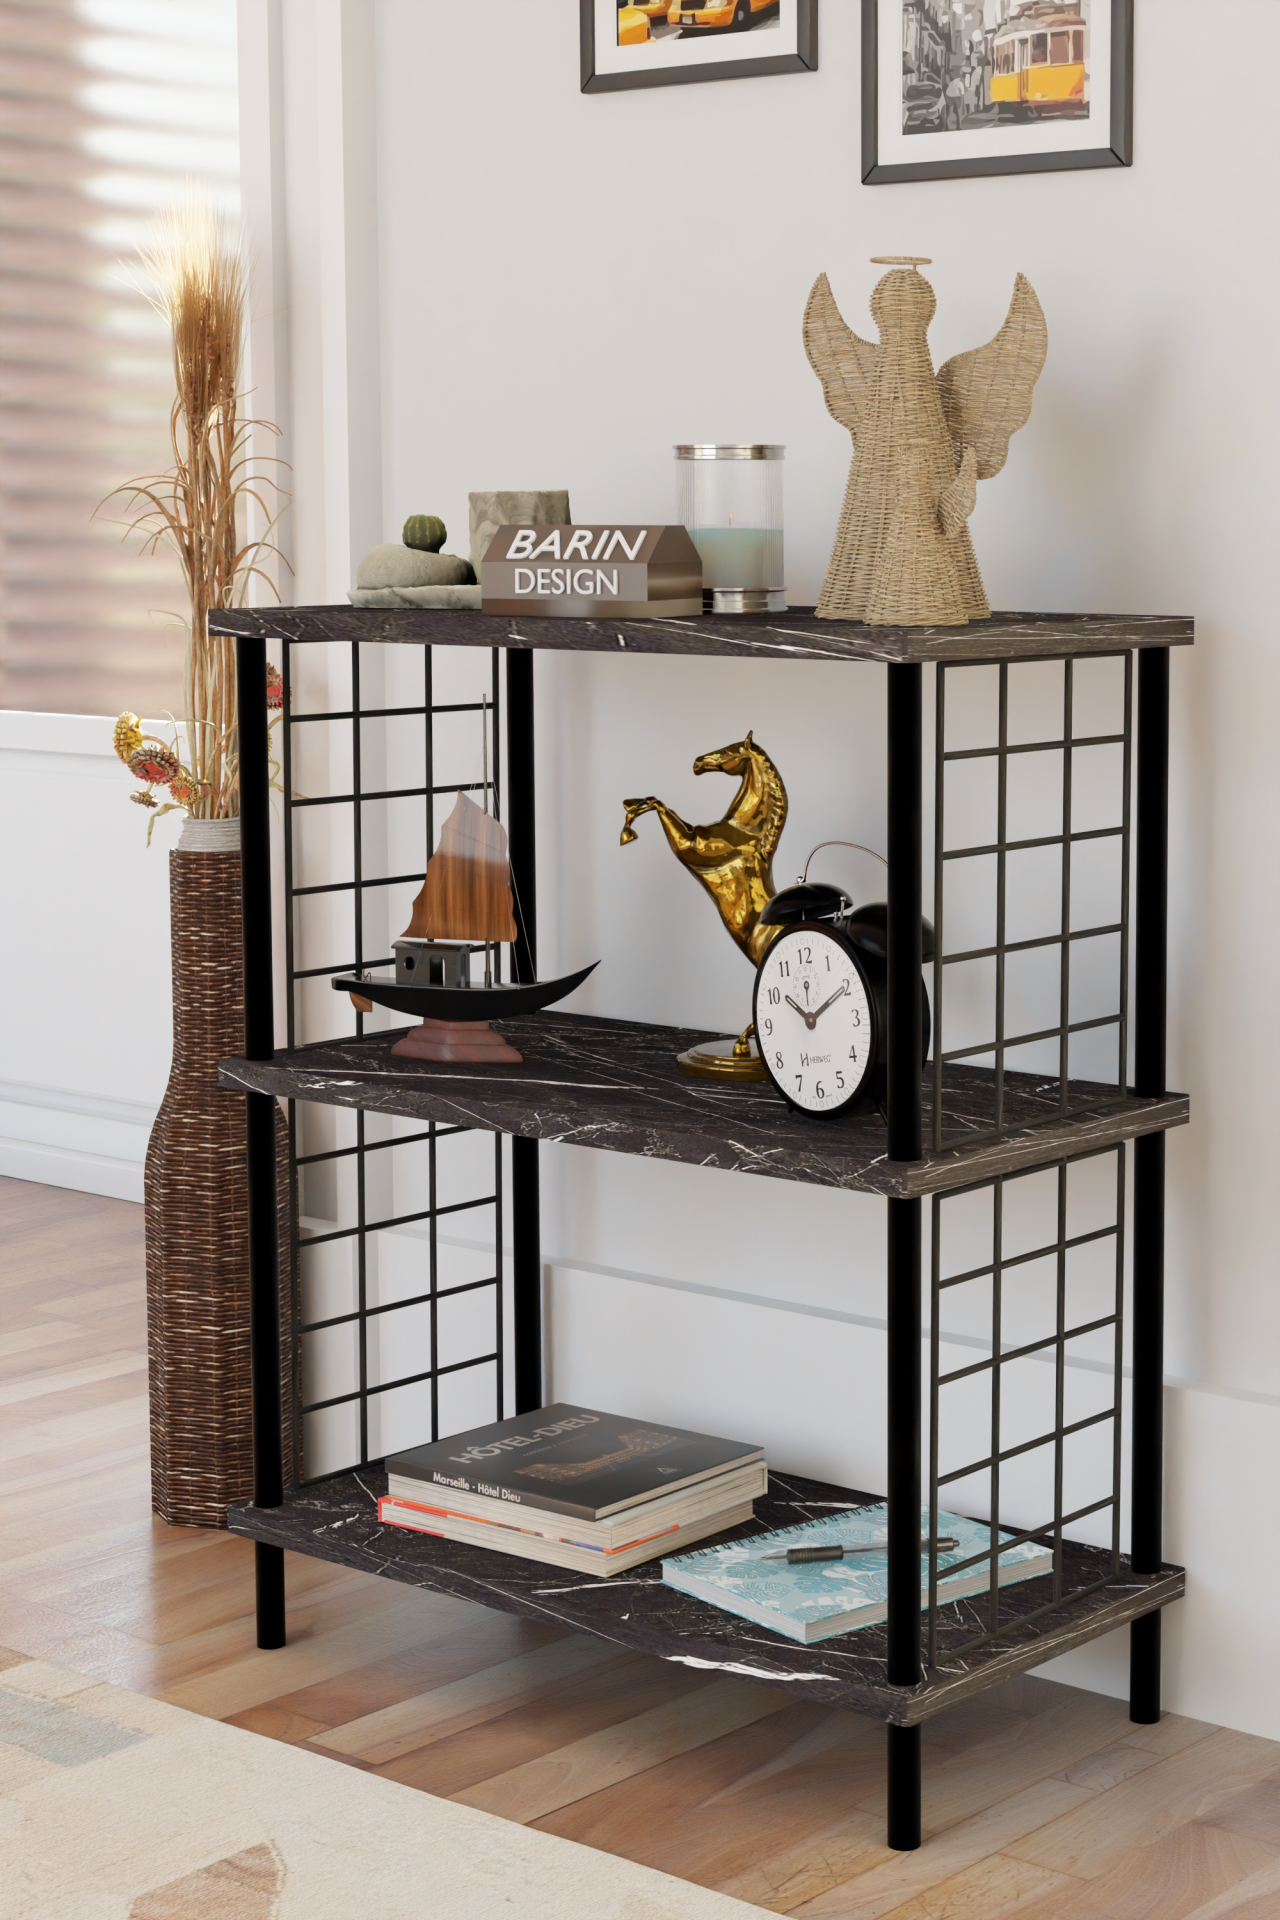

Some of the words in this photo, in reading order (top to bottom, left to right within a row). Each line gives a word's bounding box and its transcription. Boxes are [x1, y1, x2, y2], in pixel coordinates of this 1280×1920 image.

[505, 529, 648, 561] BARIN
[514, 568, 620, 596] DESIGN
[797, 947, 812, 964] 12
[824, 955, 831, 972] 1
[778, 960, 790, 977] 11
[767, 987, 781, 1005] 10
[842, 979, 851, 996] 2
[851, 1009, 861, 1027] 3
[764, 1018, 773, 1036] 9
[775, 1052, 784, 1069] 8
[849, 1045, 857, 1062] 4
[795, 1075, 803, 1092] 7
[835, 1071, 845, 1088] 5
[815, 1081, 825, 1099] 6
[448, 1414, 600, 1464] HÔTEL-DIEU
[433, 1471, 470, 1490] Marseille
[477, 1482, 500, 1498] Hôtel
[501, 1488, 521, 1503] Dieu
